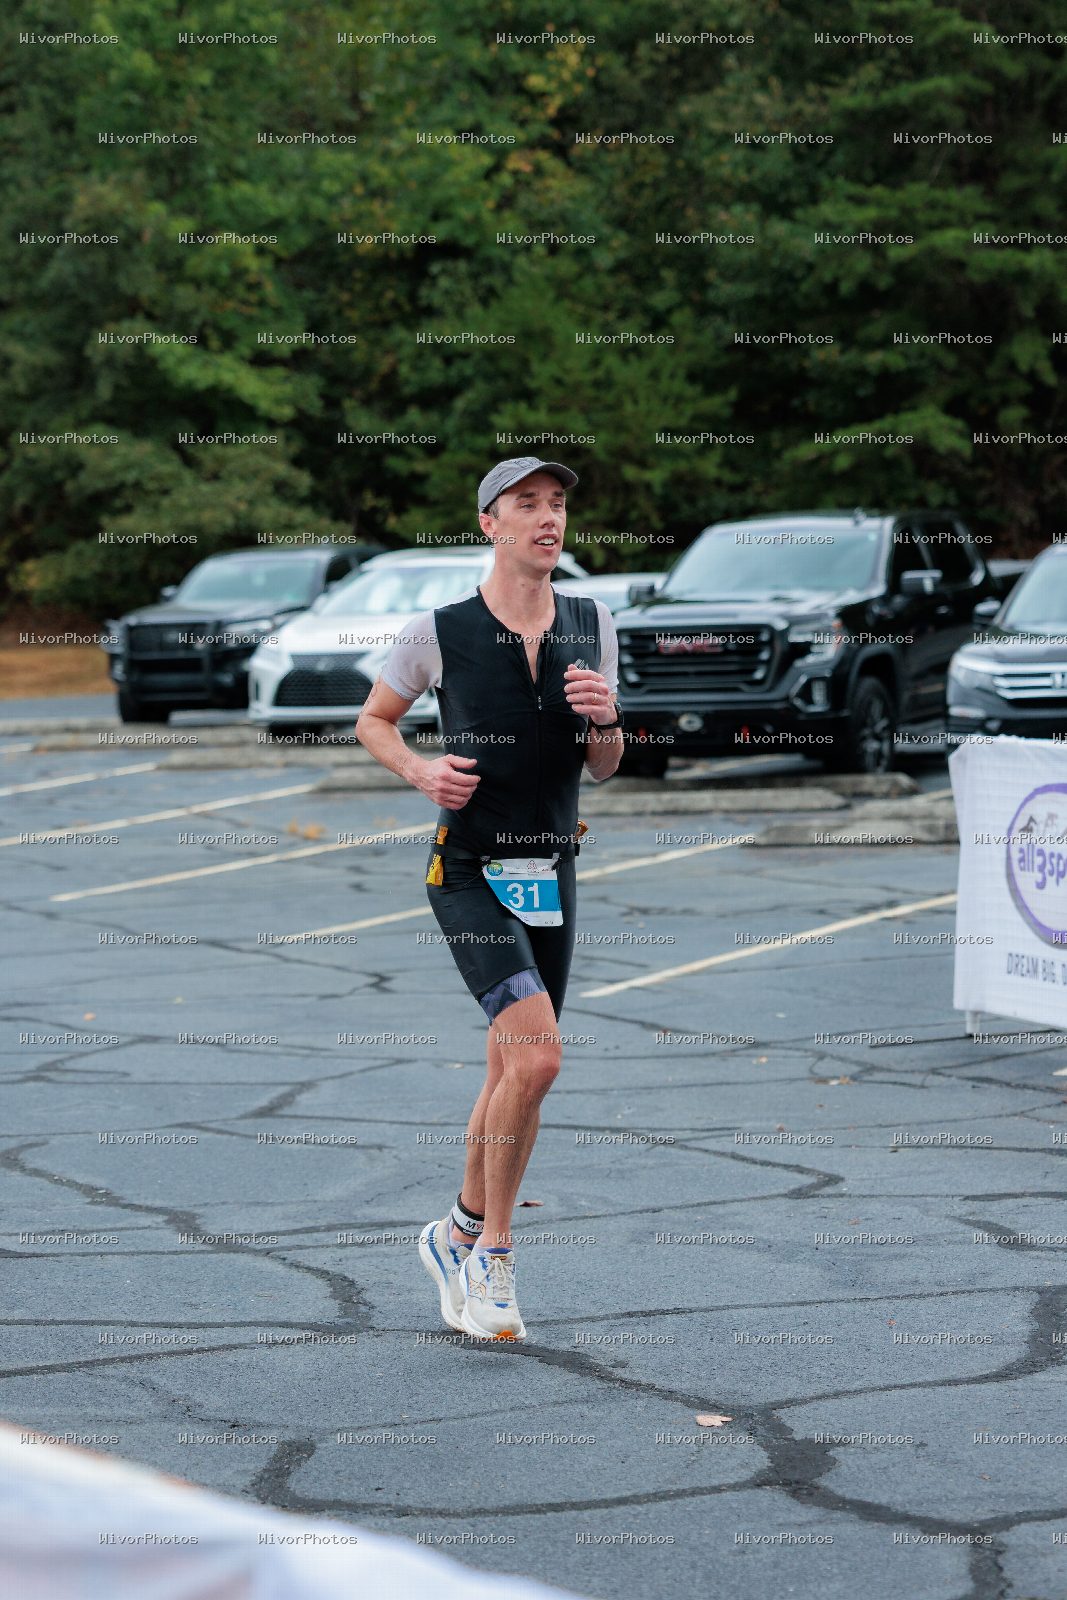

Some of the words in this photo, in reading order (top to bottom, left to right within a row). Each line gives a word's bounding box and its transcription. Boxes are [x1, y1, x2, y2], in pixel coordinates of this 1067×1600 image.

[1018, 842, 1067, 890] all3sp
[506, 882, 540, 909] 31
[1006, 952, 1039, 980] DREAM
